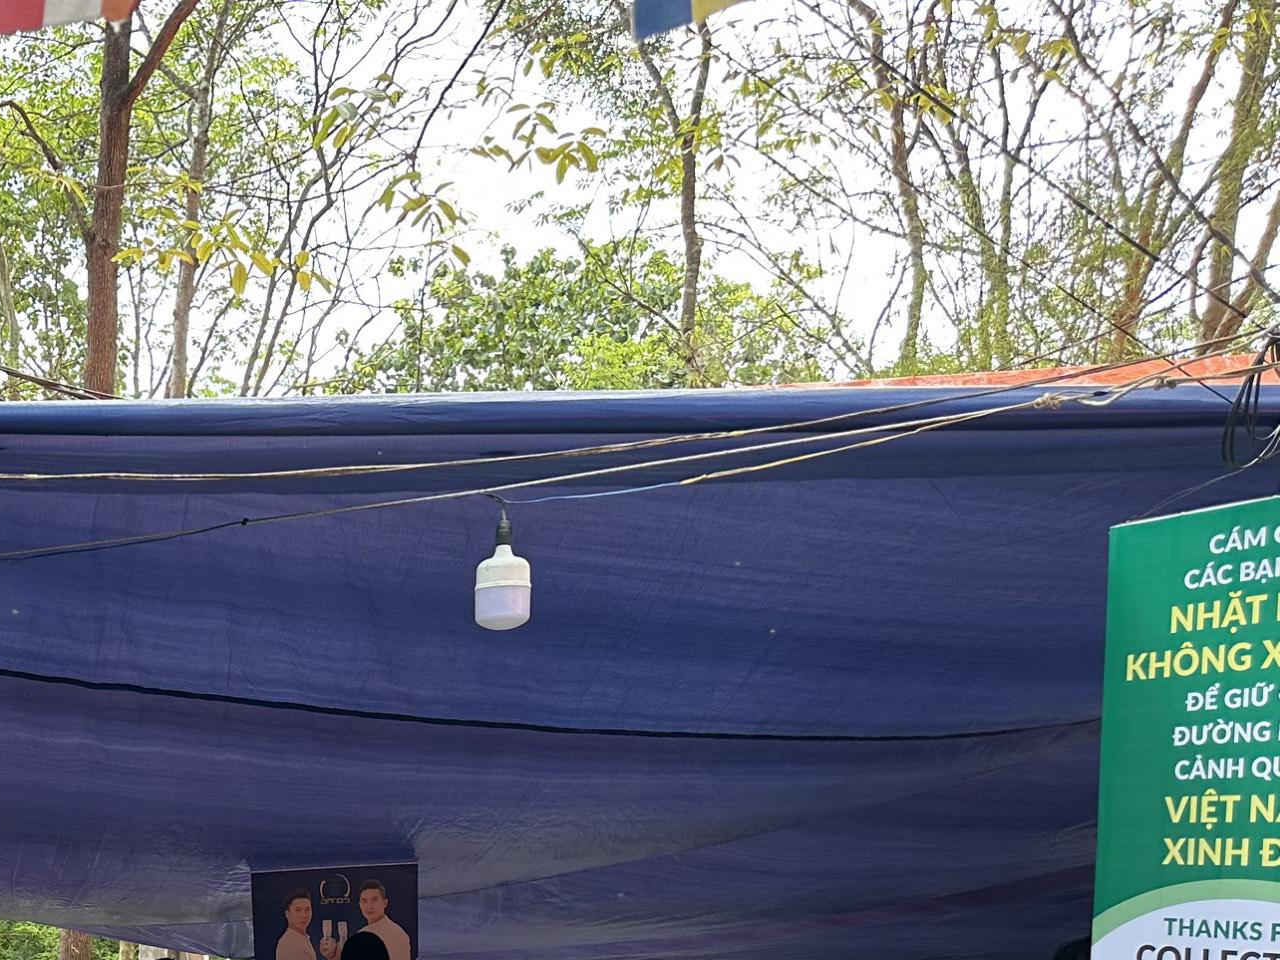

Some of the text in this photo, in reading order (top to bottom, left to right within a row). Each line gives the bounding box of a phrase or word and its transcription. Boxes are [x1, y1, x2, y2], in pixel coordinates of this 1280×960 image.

[1209, 525, 1267, 554] CÁM
[1184, 557, 1280, 590] CÁC BẠ
[1170, 591, 1268, 634] NHẶT
[1126, 641, 1253, 681] KHÔNG
[1185, 682, 1275, 712] ĐỂ GIỮ
[1173, 718, 1271, 747] ĐƯỜNG
[1174, 755, 1245, 780] CẢNH
[1165, 788, 1280, 830] VIỆT N
[1162, 838, 1250, 866] XINH
[1164, 917, 1263, 941] THANKS
